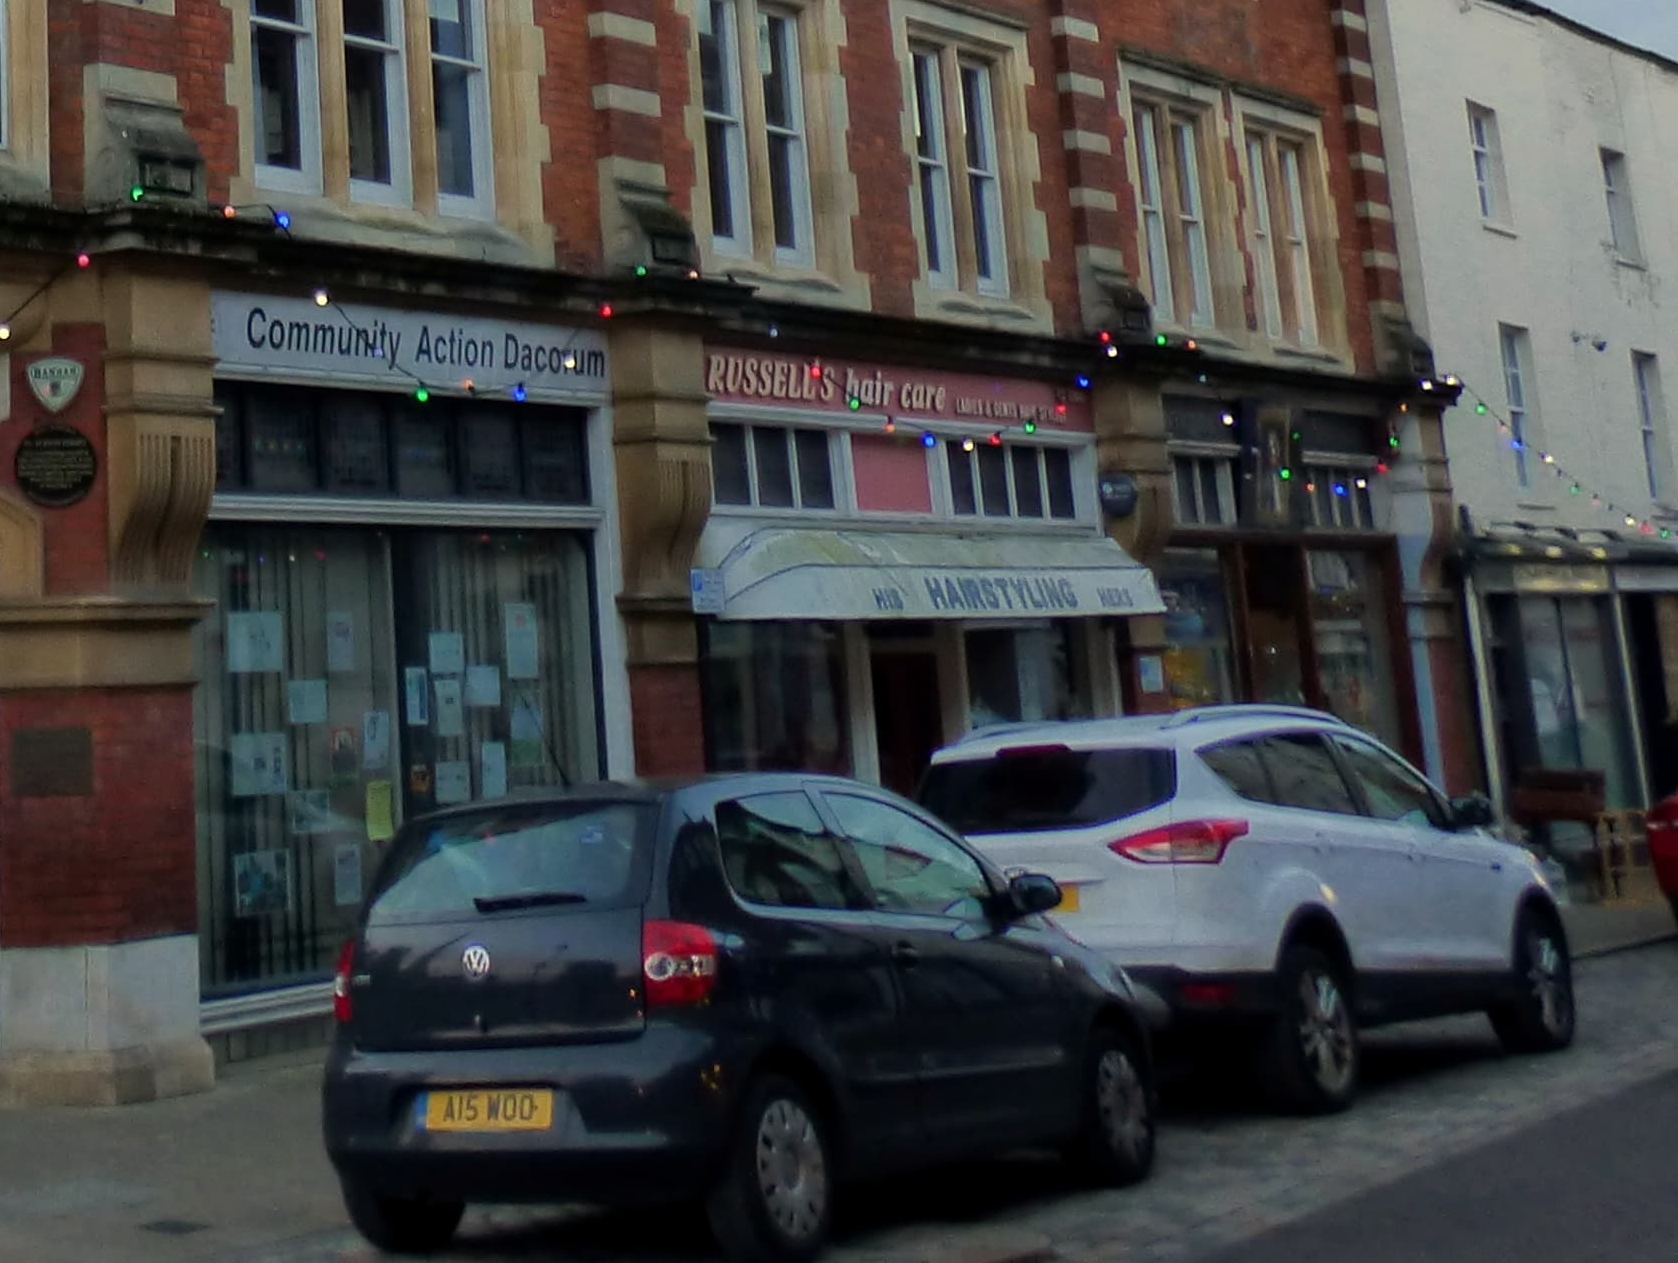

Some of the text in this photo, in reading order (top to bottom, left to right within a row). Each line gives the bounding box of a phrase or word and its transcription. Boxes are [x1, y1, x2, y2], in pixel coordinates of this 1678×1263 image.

[246, 307, 606, 378] Community Action Dacorum
[706, 353, 947, 412] RUSSELL'S hair care
[924, 576, 1079, 611] HAIRSTYLING
